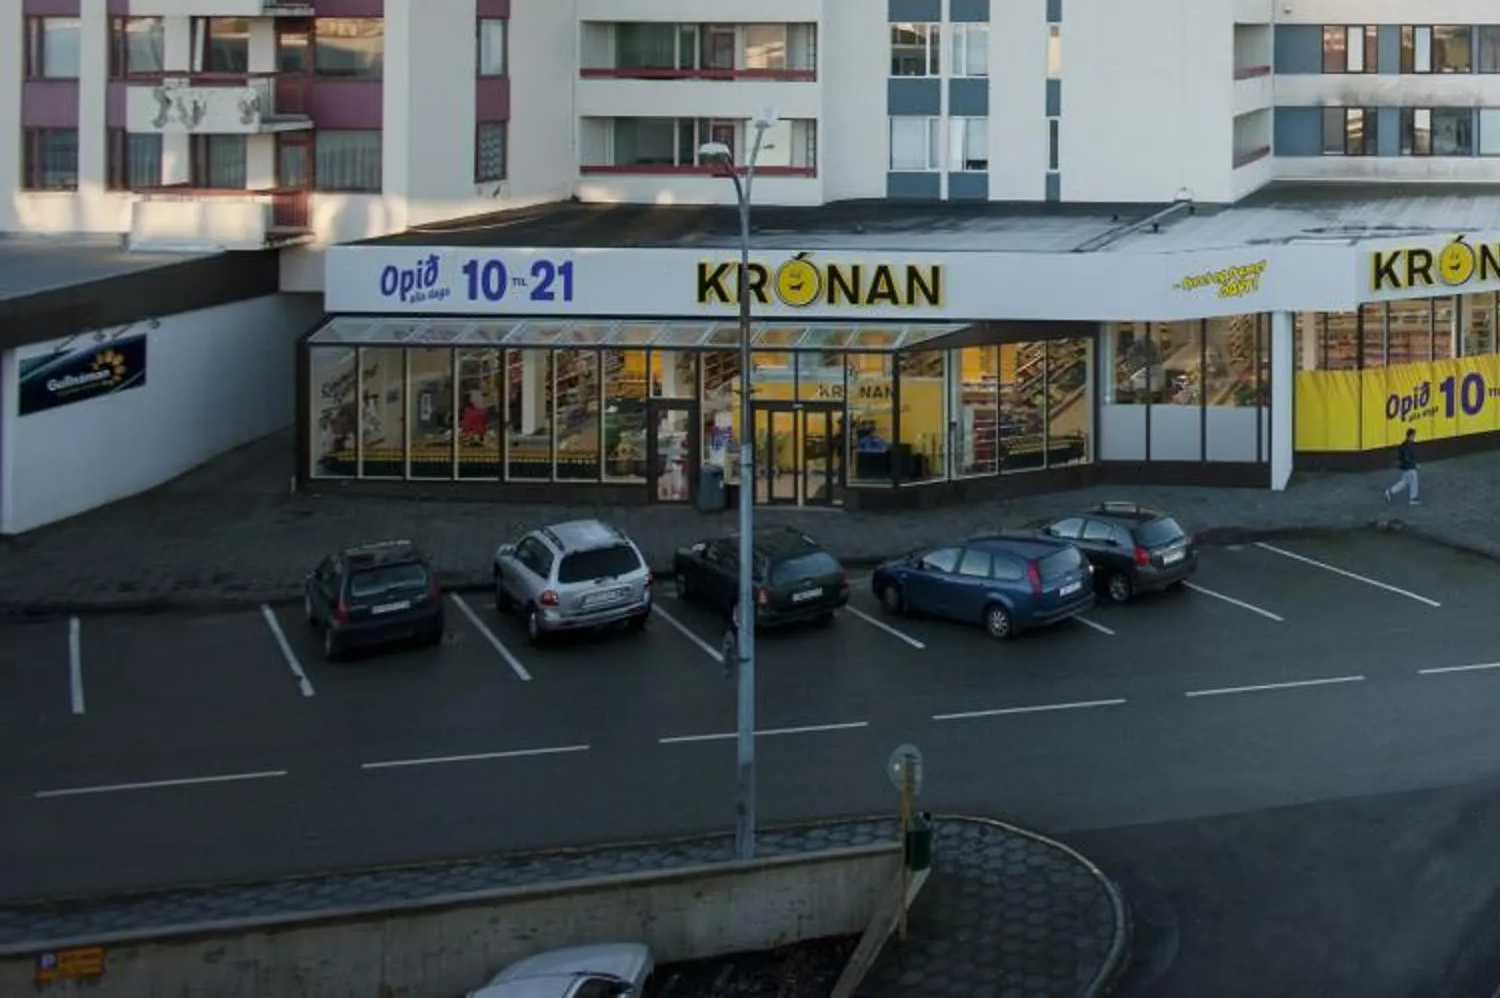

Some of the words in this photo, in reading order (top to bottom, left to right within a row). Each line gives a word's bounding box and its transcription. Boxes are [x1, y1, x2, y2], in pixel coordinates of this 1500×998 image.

[380, 253, 440, 302] Opið
[462, 258, 508, 302] 10
[530, 259, 574, 302] 21
[697, 251, 943, 307] KRÓNAN
[1439, 371, 1486, 419] 10
